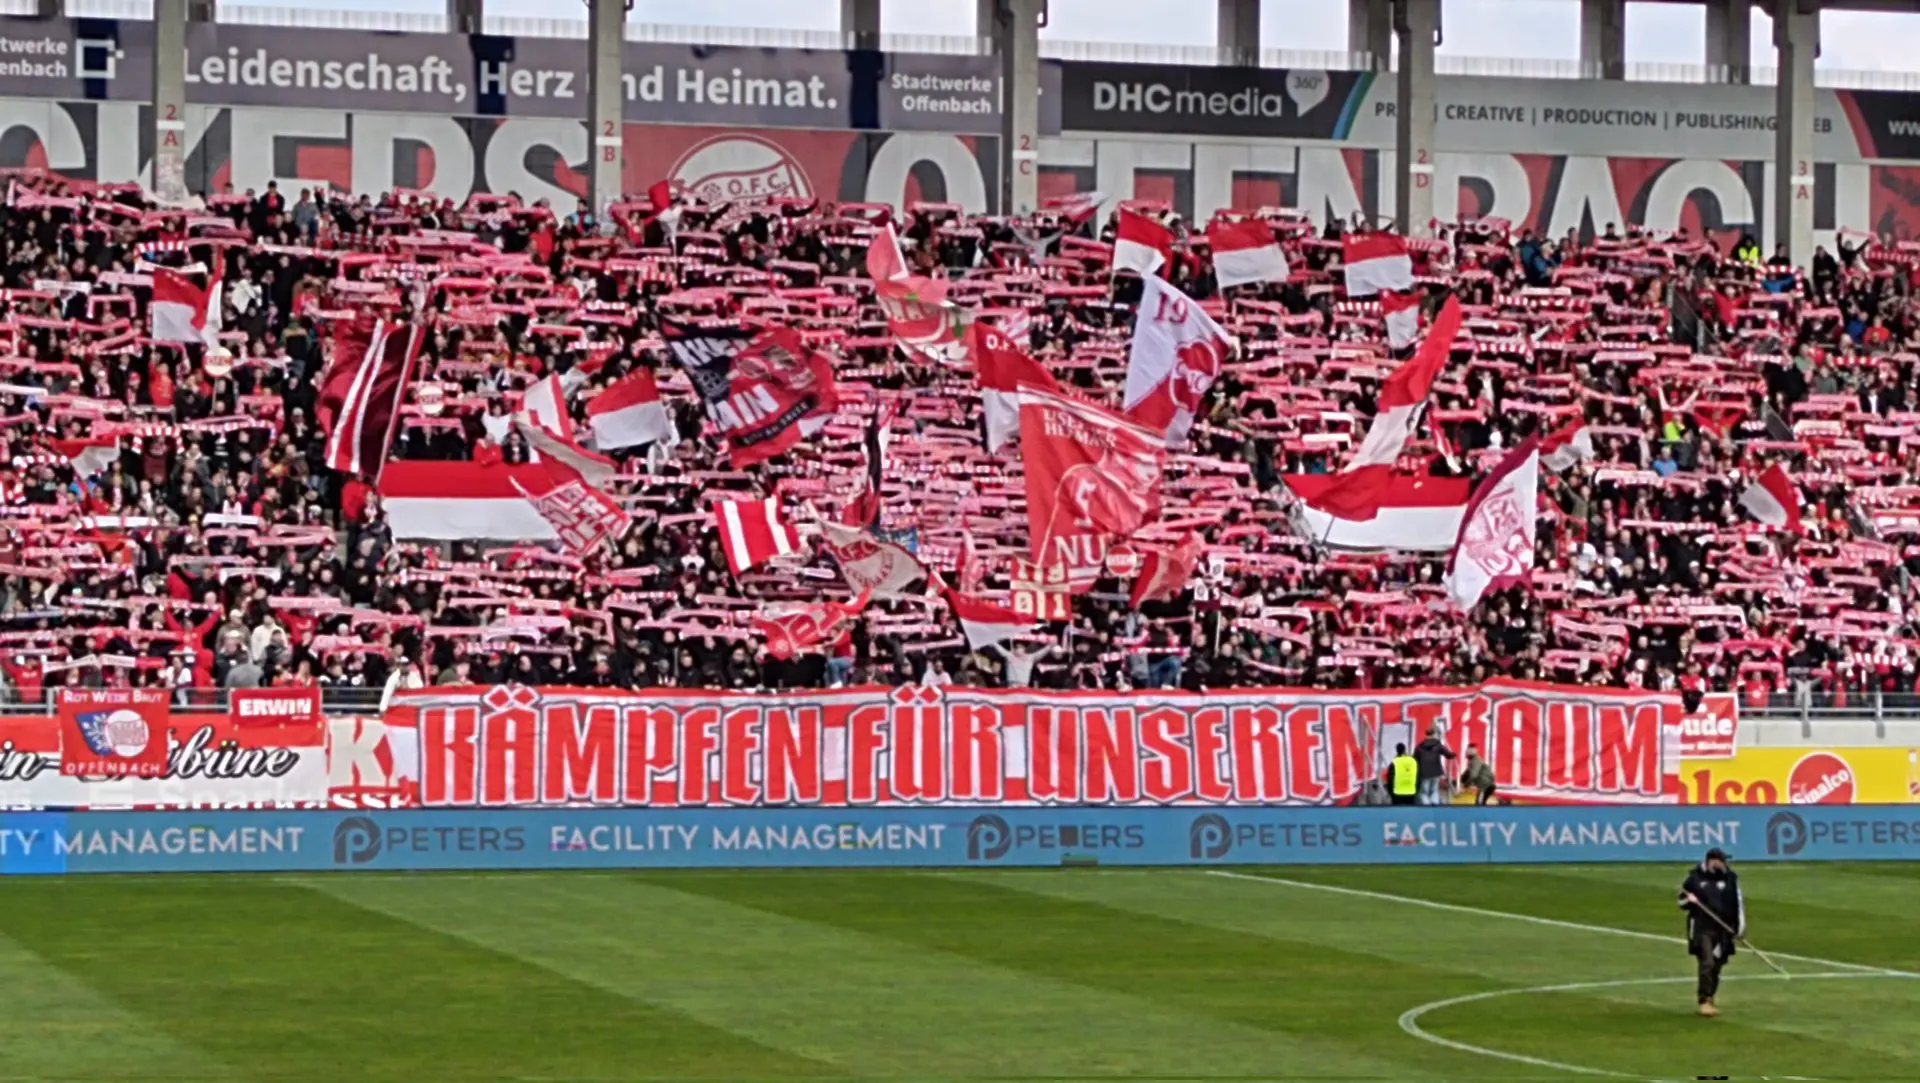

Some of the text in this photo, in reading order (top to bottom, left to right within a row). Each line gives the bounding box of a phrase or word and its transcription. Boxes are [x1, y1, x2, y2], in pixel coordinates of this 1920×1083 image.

[184, 45, 467, 102] Leidenschaft,
[479, 60, 575, 98] Herz
[677, 68, 838, 110] Heimat.
[892, 73, 992, 93] Stadtwerke
[902, 95, 992, 115] Offenbach
[1093, 81, 1282, 117] DHCmedia
[166, 105, 176, 120] 2
[1445, 104, 1525, 123] CREATIVE
[1543, 108, 1657, 127] PRODUCTION
[1676, 112, 1778, 131] PUBLISHING
[163, 129, 178, 146] A
[604, 121, 615, 136] 2
[1019, 134, 1030, 150] 2
[603, 147, 615, 163] B
[1417, 149, 1427, 164] 2
[1019, 159, 1031, 175] C
[1415, 172, 1428, 188] D
[1796, 186, 1809, 200] A
[239, 698, 312, 717] ERWIN
[419, 684, 1665, 806] KÄMPFEN FÜR UNSEREN TRAUM
[66, 761, 161, 775] OFFENBACH
[1791, 769, 1850, 804] Sinalco
[54, 826, 305, 856] MANAGEMENT
[387, 827, 526, 852] PETERS
[550, 823, 946, 852] FACILITY MANAGEMENT
[1015, 824, 1145, 848] PEERS
[1242, 823, 1361, 847] PETERS
[1383, 820, 1741, 847] FACILITY MANAGEMENT
